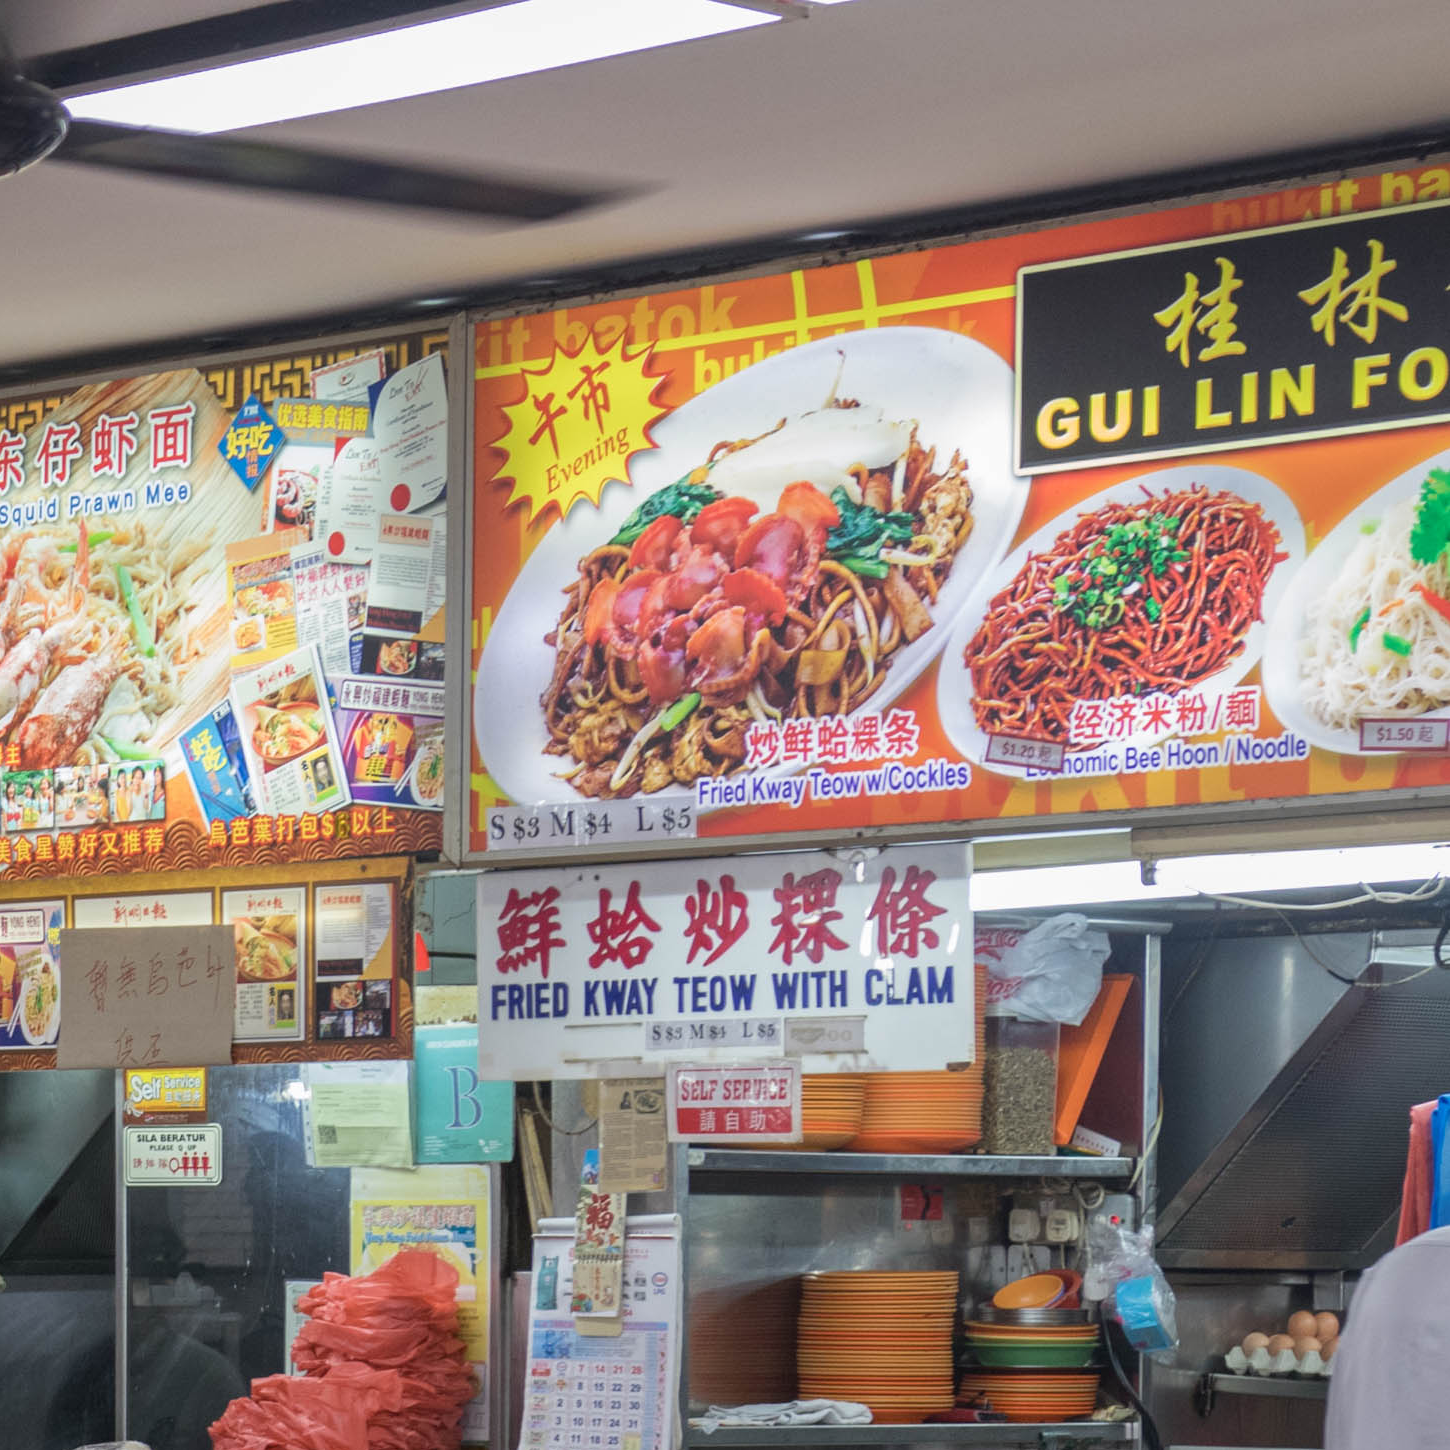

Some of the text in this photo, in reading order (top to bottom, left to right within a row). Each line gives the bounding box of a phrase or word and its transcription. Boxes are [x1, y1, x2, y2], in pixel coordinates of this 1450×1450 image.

[1154, 239, 1409, 369] 桂林
[277, 402, 369, 431] 优选美食指南
[1036, 347, 1450, 450] GUI LIN FO
[545, 427, 631, 494] Evening
[69, 487, 134, 516] Prawn
[145, 481, 190, 506] Mee
[748, 713, 919, 765] 炒鲜蛤粿条
[1002, 741, 1034, 758] $1.20
[1124, 734, 1307, 770] Bee Hoon Noodle
[1376, 727, 1415, 743] $1.50
[699, 764, 968, 805] Fried Kway Teow w/Cockles
[491, 806, 691, 844] S $3 M $4 L $5
[496, 864, 949, 979] 鮮蛤炒粿條
[491, 981, 569, 1021] FRIED
[583, 977, 659, 1018] KWAY
[673, 974, 757, 1013] TEOW
[772, 970, 848, 1010] WITH
[865, 966, 955, 1007] CLAM
[652, 1025, 661, 1040] S
[690, 1024, 704, 1039] M
[742, 1022, 753, 1038] L
[757, 1024, 775, 1038] $5
[131, 1075, 201, 1102] Self Service
[444, 1065, 483, 1130] B
[681, 1078, 788, 1101] SELF SERVICE
[137, 1134, 206, 1142] SILA BERATUR
[700, 1110, 766, 1132] 請自助
